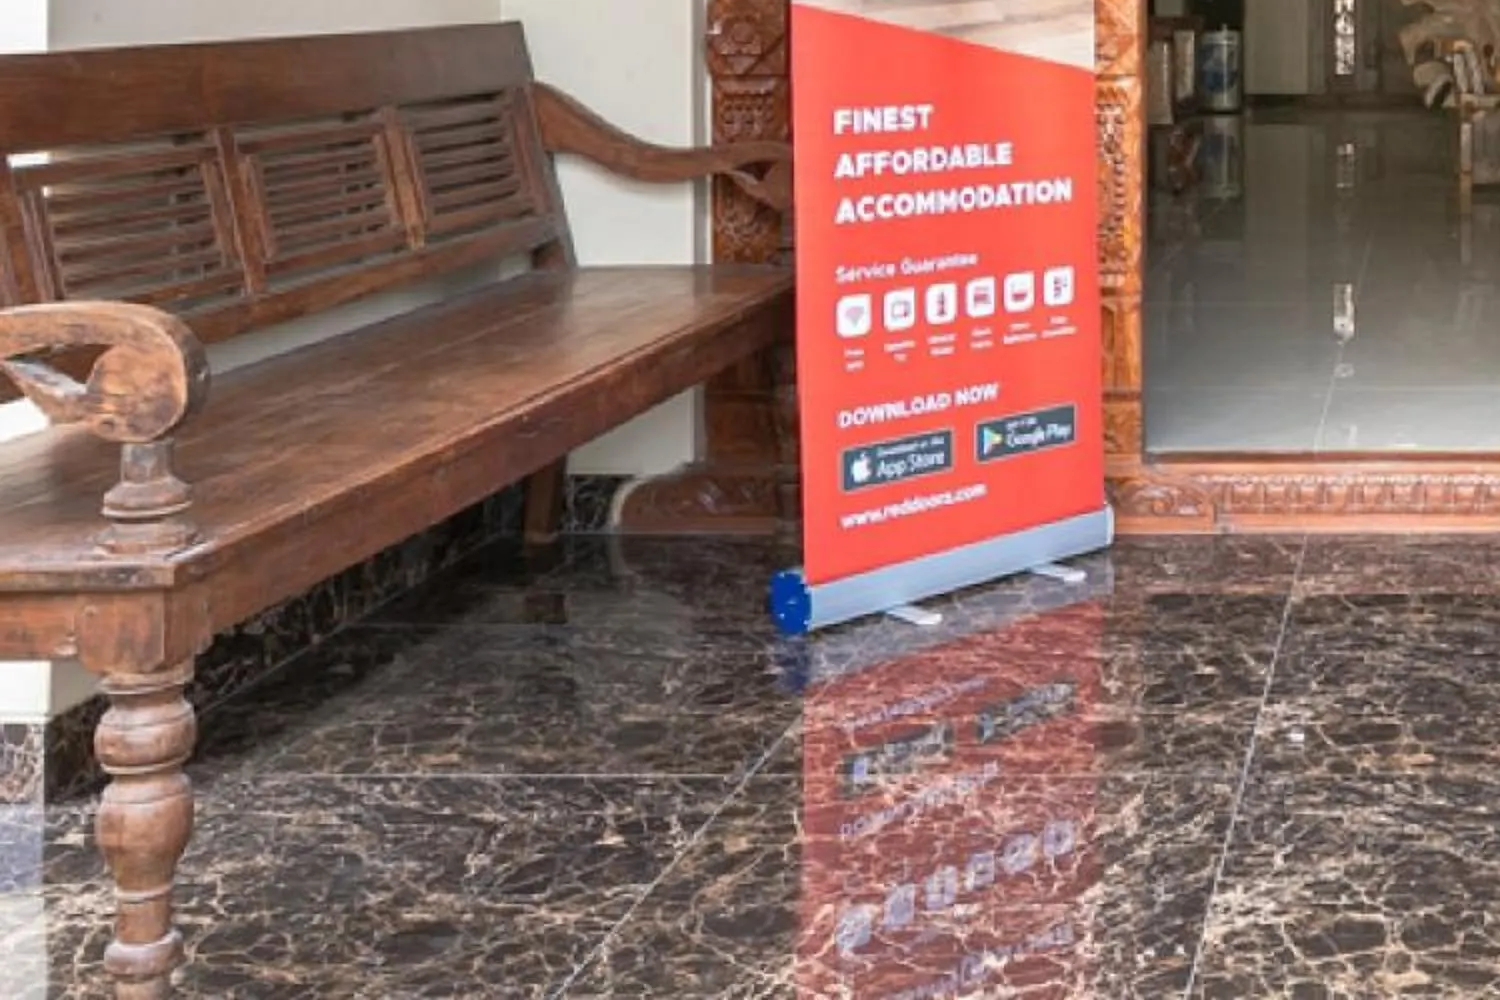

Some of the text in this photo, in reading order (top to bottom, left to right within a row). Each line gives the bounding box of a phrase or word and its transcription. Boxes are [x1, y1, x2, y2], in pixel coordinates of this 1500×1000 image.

[833, 104, 933, 135] FINEST
[834, 142, 1013, 179] AFFORDABLE
[835, 177, 1072, 224] ACCOMMODATION
[835, 263, 896, 282] Service
[837, 383, 999, 428] DOWNLOAD NOW
[877, 451, 945, 478] App Store
